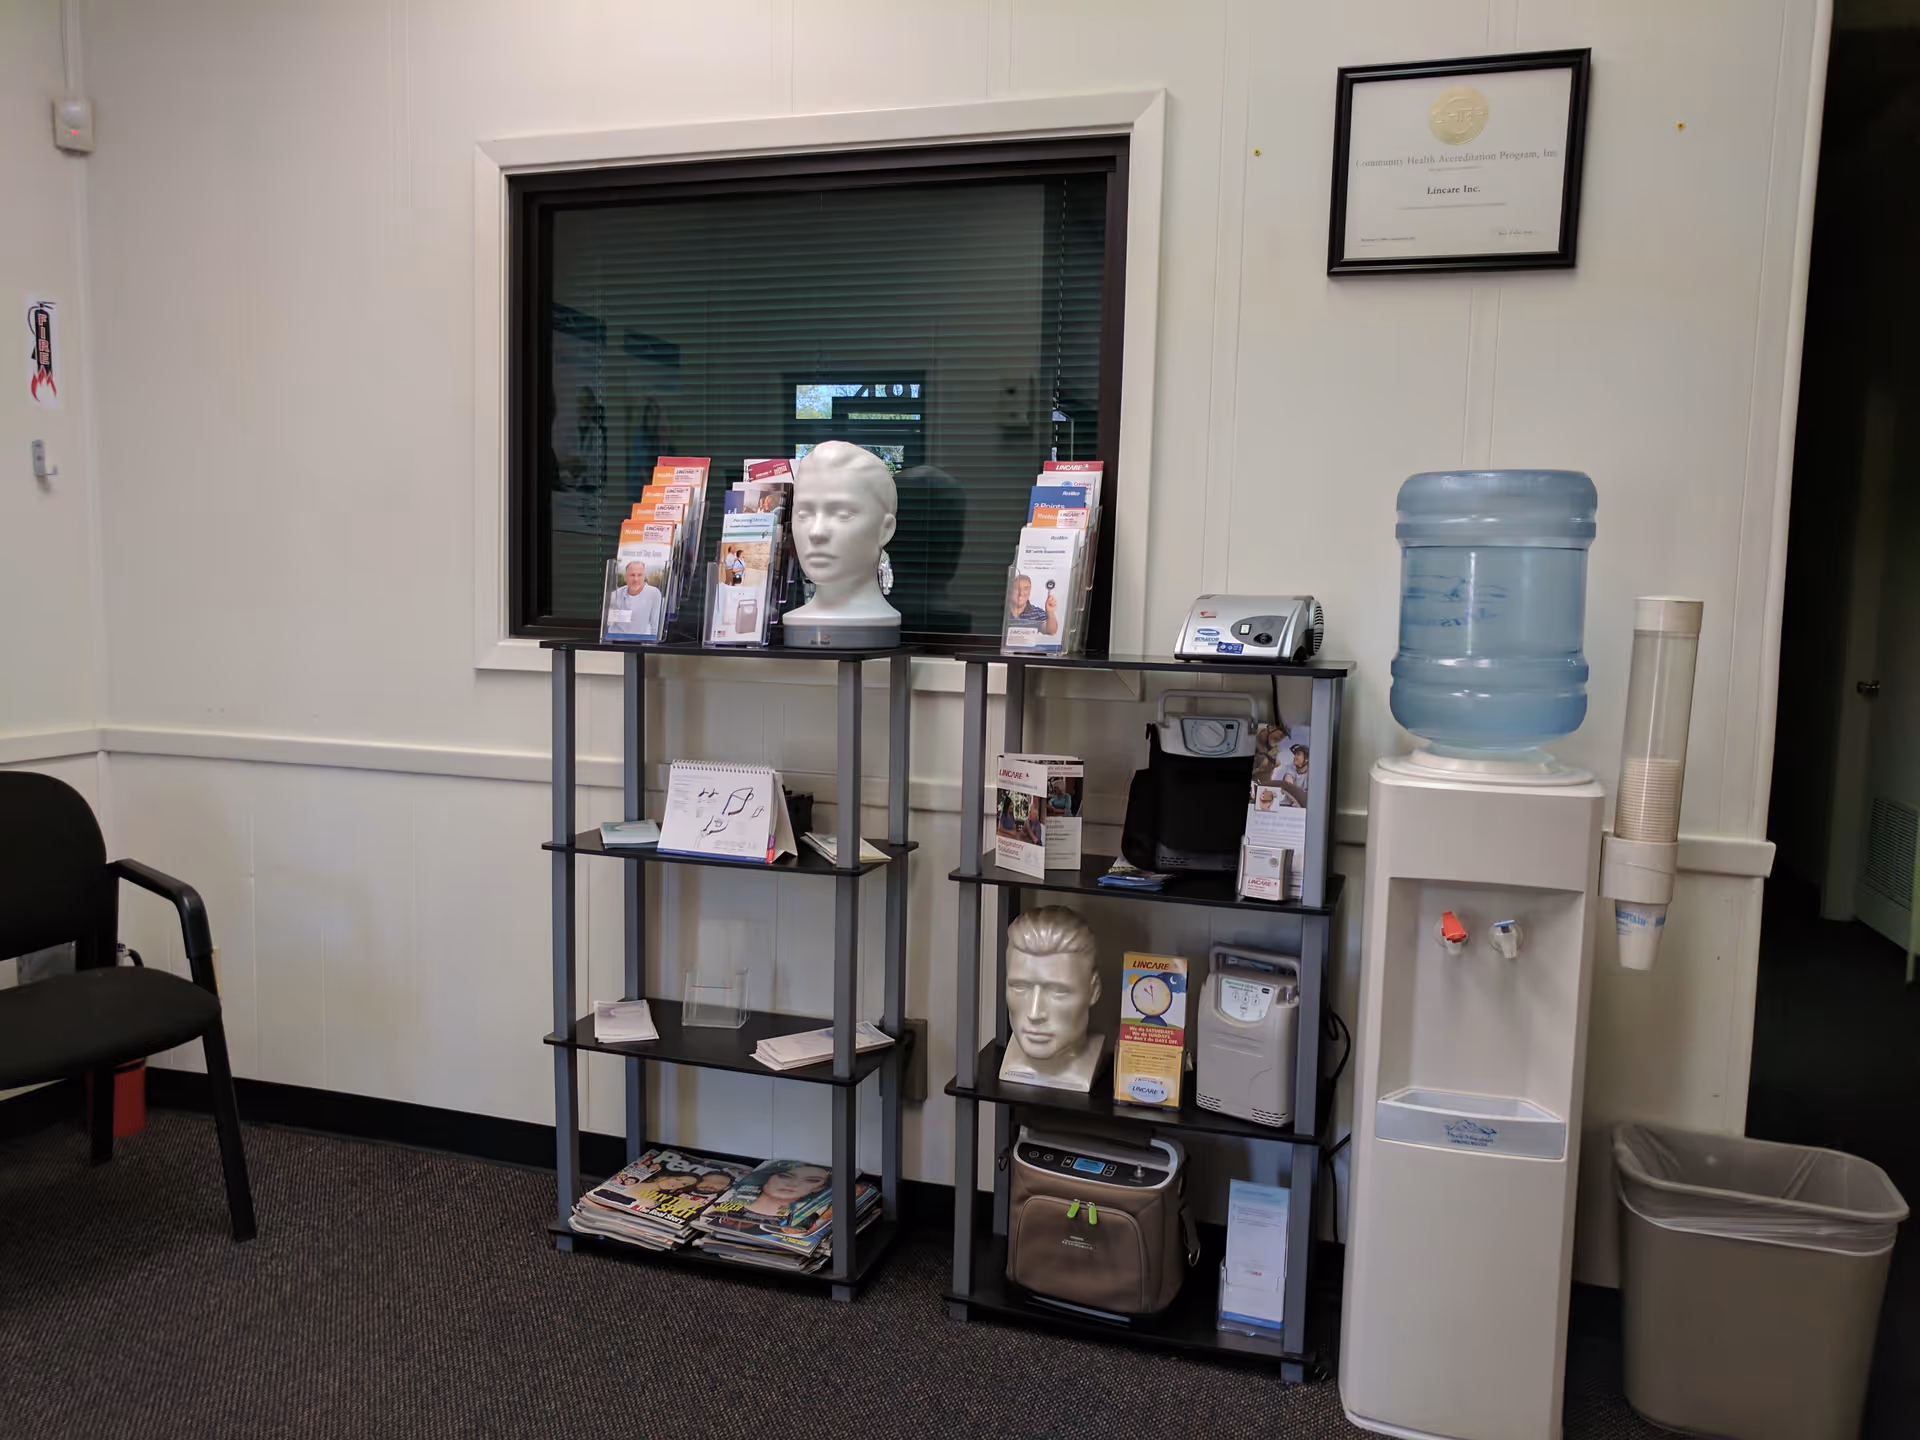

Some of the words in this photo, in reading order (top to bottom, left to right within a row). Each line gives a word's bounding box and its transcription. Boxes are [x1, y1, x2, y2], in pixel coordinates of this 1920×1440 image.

[1356, 159, 1403, 167] Community
[1407, 155, 1435, 165] Health
[1438, 151, 1496, 163] Accreditation
[1500, 150, 1540, 161] Program,
[1427, 186, 1460, 195] Lincare
[1463, 185, 1481, 193] Inc.
[38, 313, 50, 365] FIRE
[999, 769, 1022, 780] LINCARE
[1132, 960, 1169, 970] LINCARE
[1132, 1086, 1157, 1095] LINCARE
[640, 1190, 673, 1202] WHY
[649, 1208, 667, 1218] Real
[665, 1212, 686, 1224] Story
[656, 1203, 697, 1219] SPLIT
